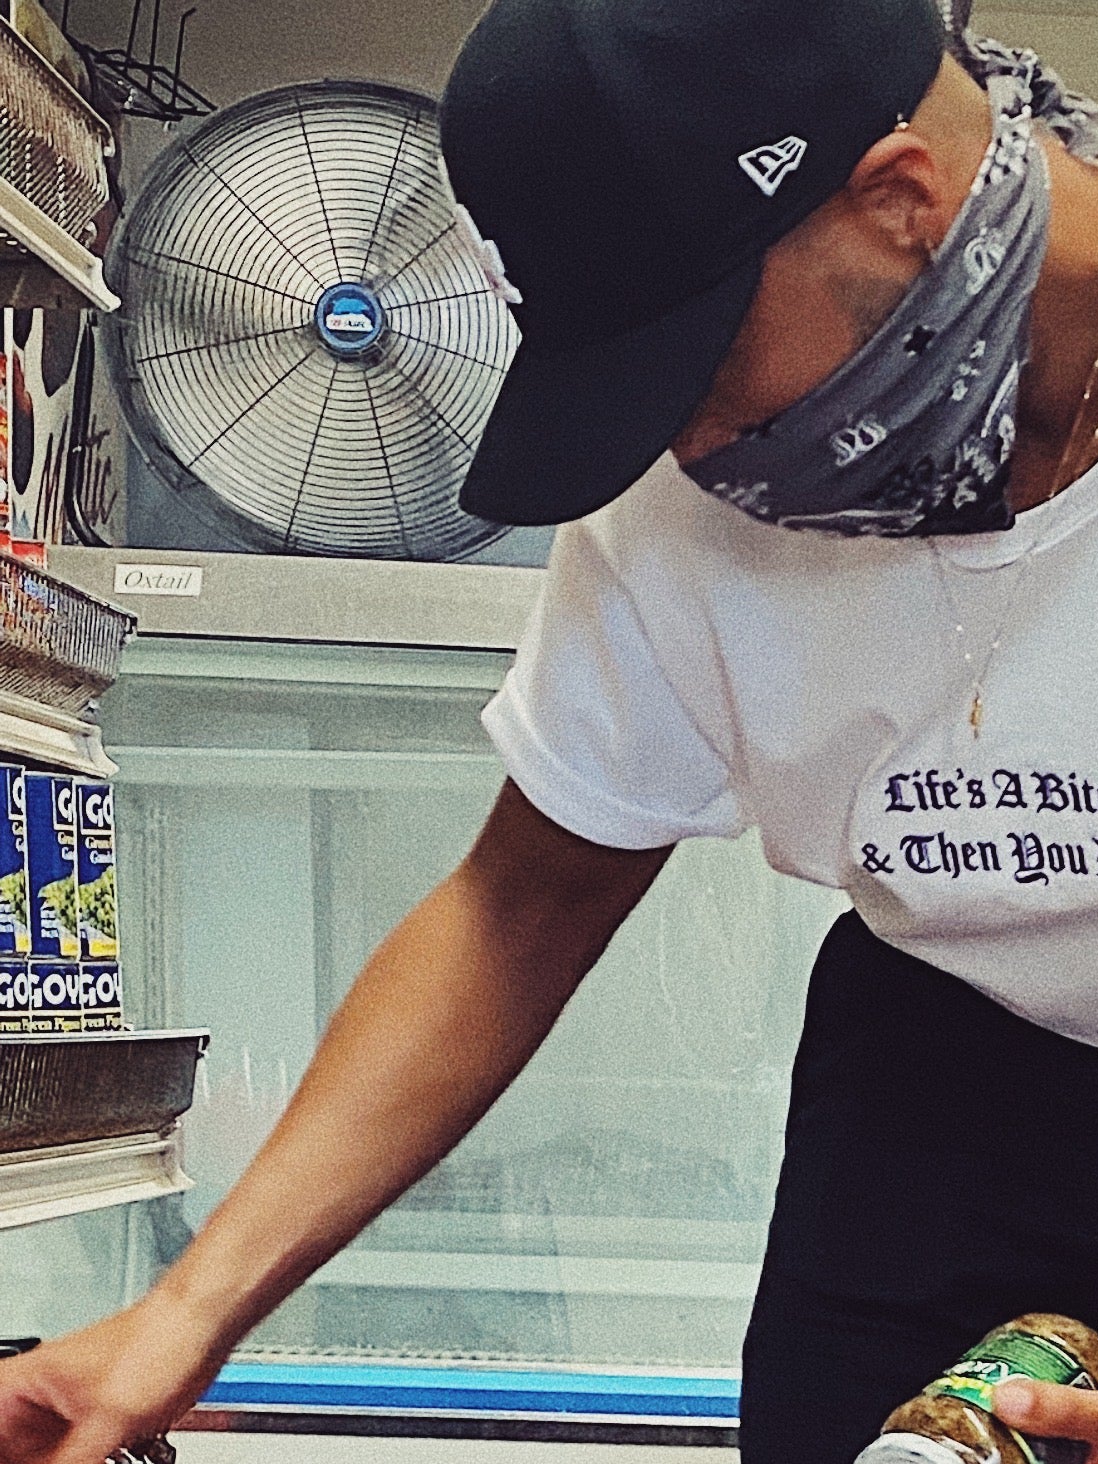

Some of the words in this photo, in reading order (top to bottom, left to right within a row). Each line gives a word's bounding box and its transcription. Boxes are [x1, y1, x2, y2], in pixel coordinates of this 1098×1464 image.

[124, 571, 192, 589] Oxtail
[884, 768, 987, 813] Life's
[992, 769, 1028, 809] A
[861, 843, 895, 874] &
[899, 830, 1002, 879] Then
[1007, 832, 1089, 886] You
